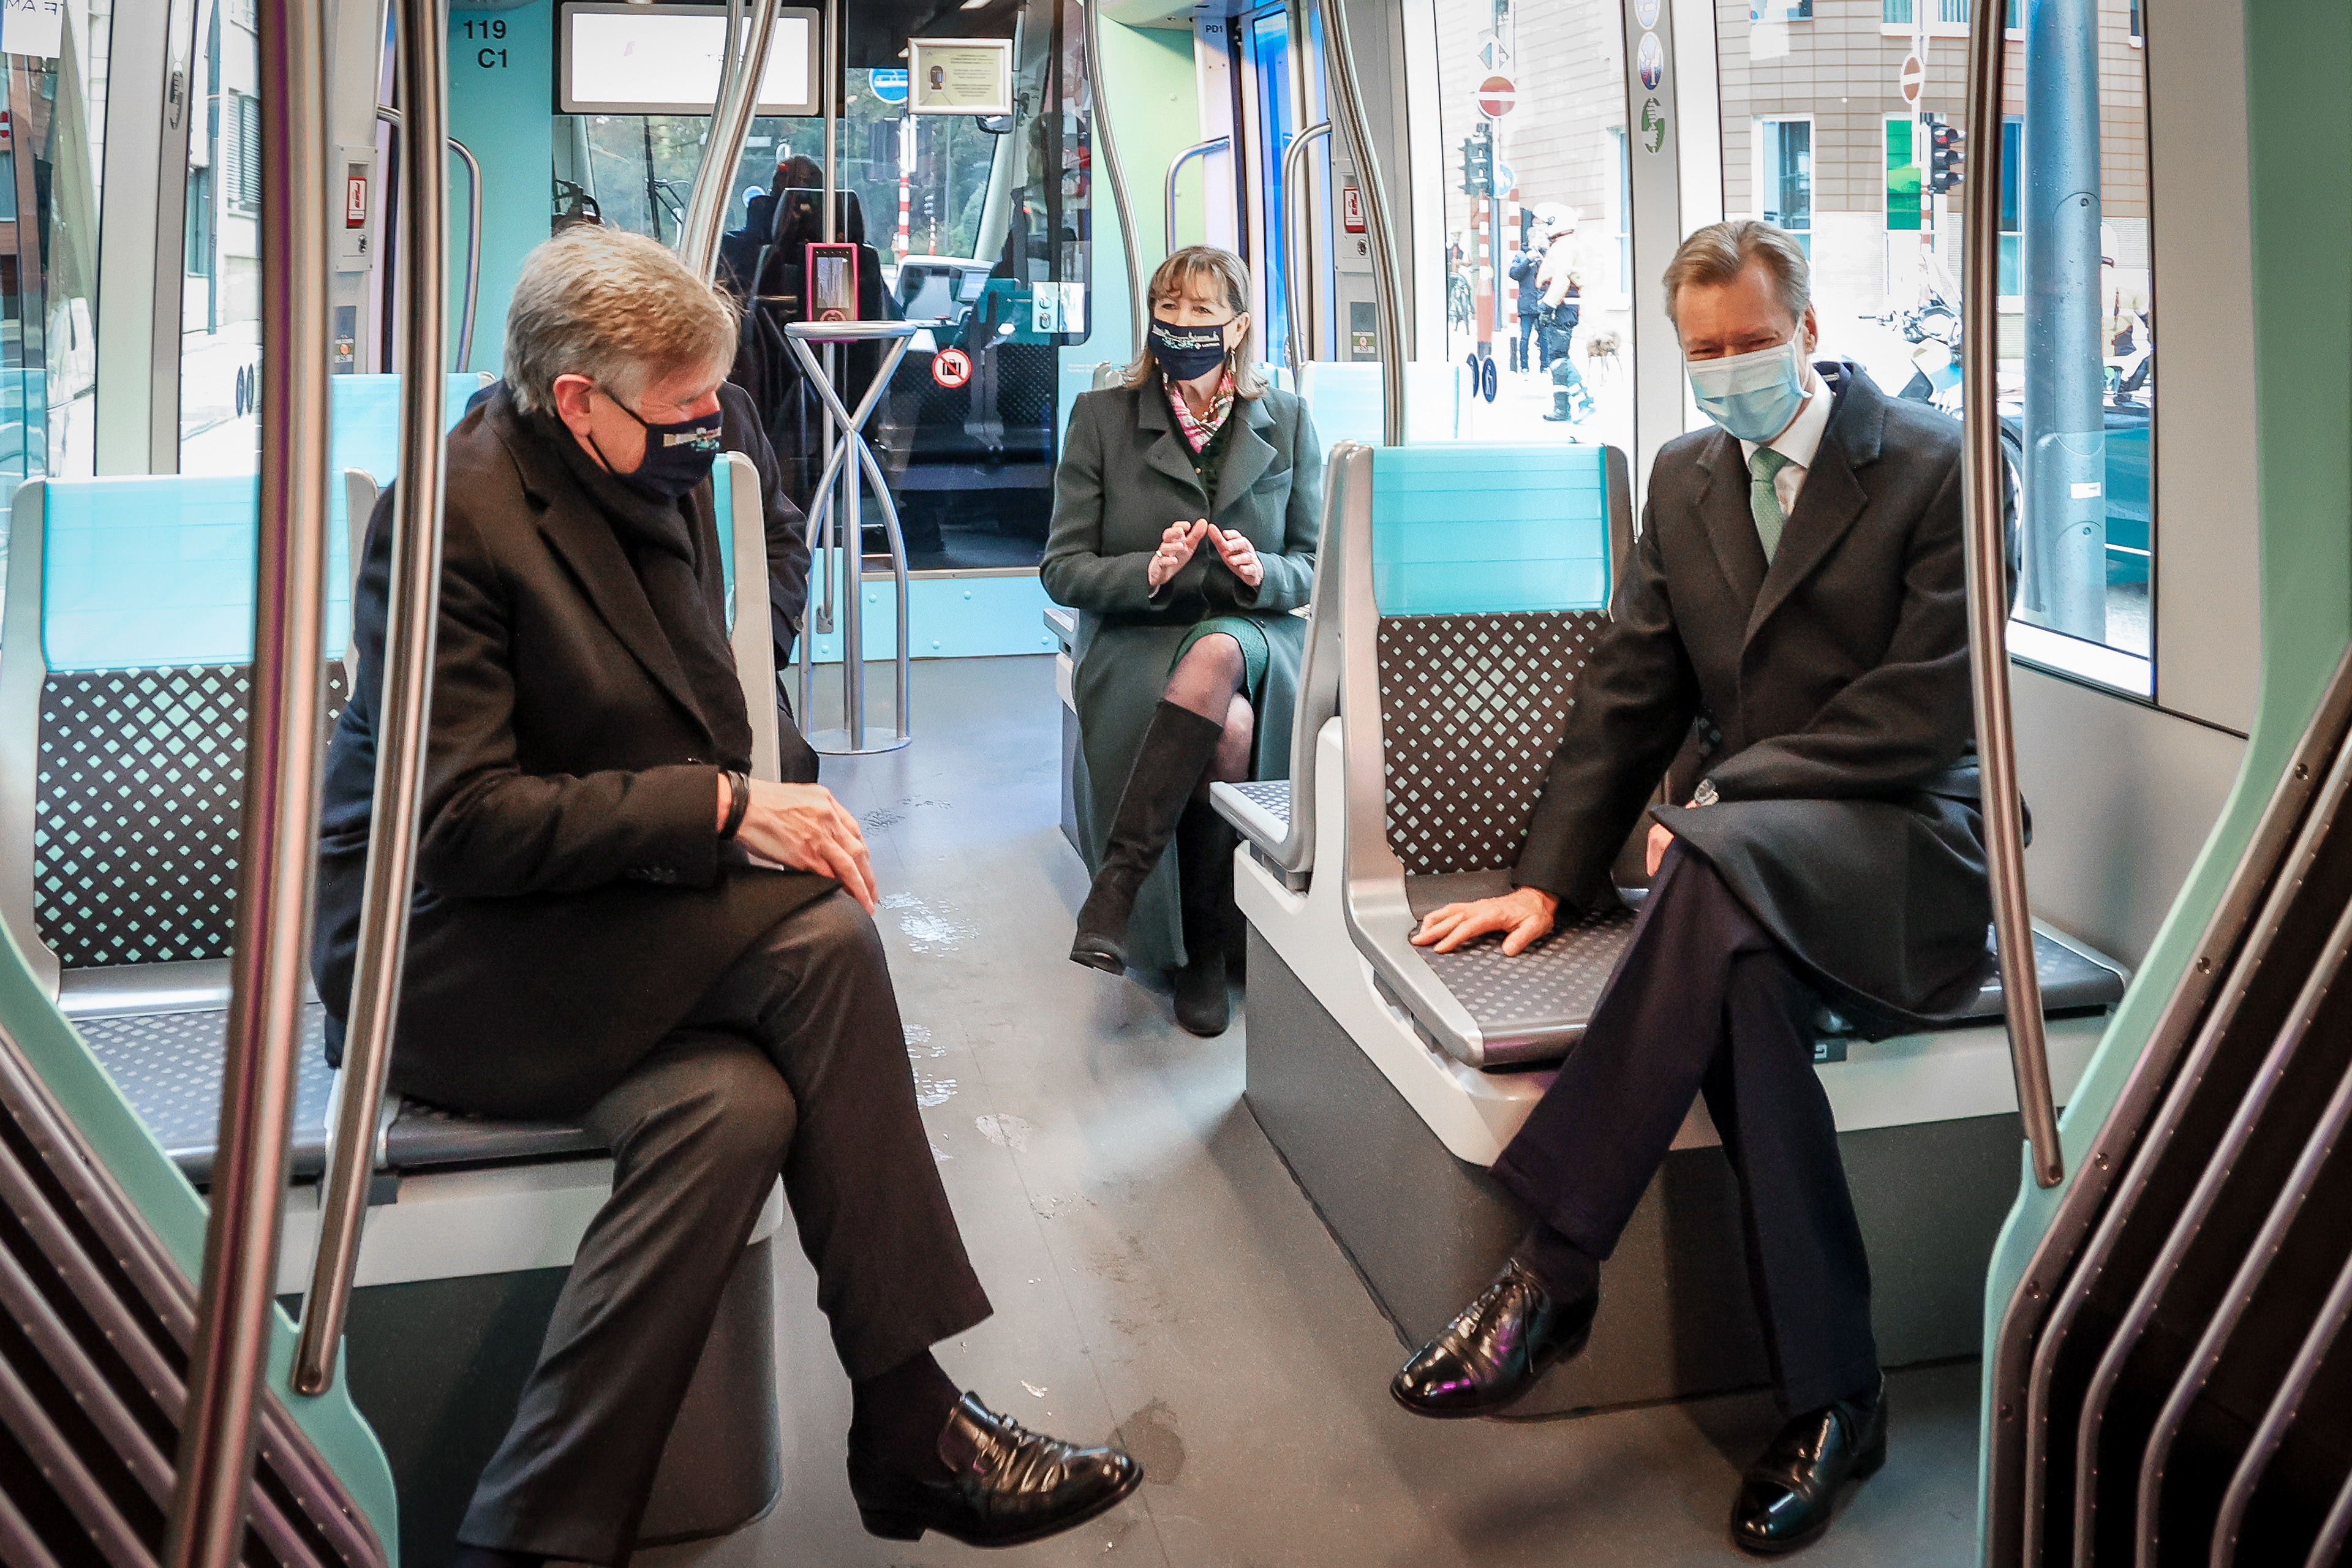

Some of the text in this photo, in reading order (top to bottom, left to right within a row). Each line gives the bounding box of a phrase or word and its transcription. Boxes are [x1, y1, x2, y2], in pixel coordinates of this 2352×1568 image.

[463, 19, 507, 40] 119
[1205, 24, 1223, 33] PD1
[478, 48, 507, 68] C1
